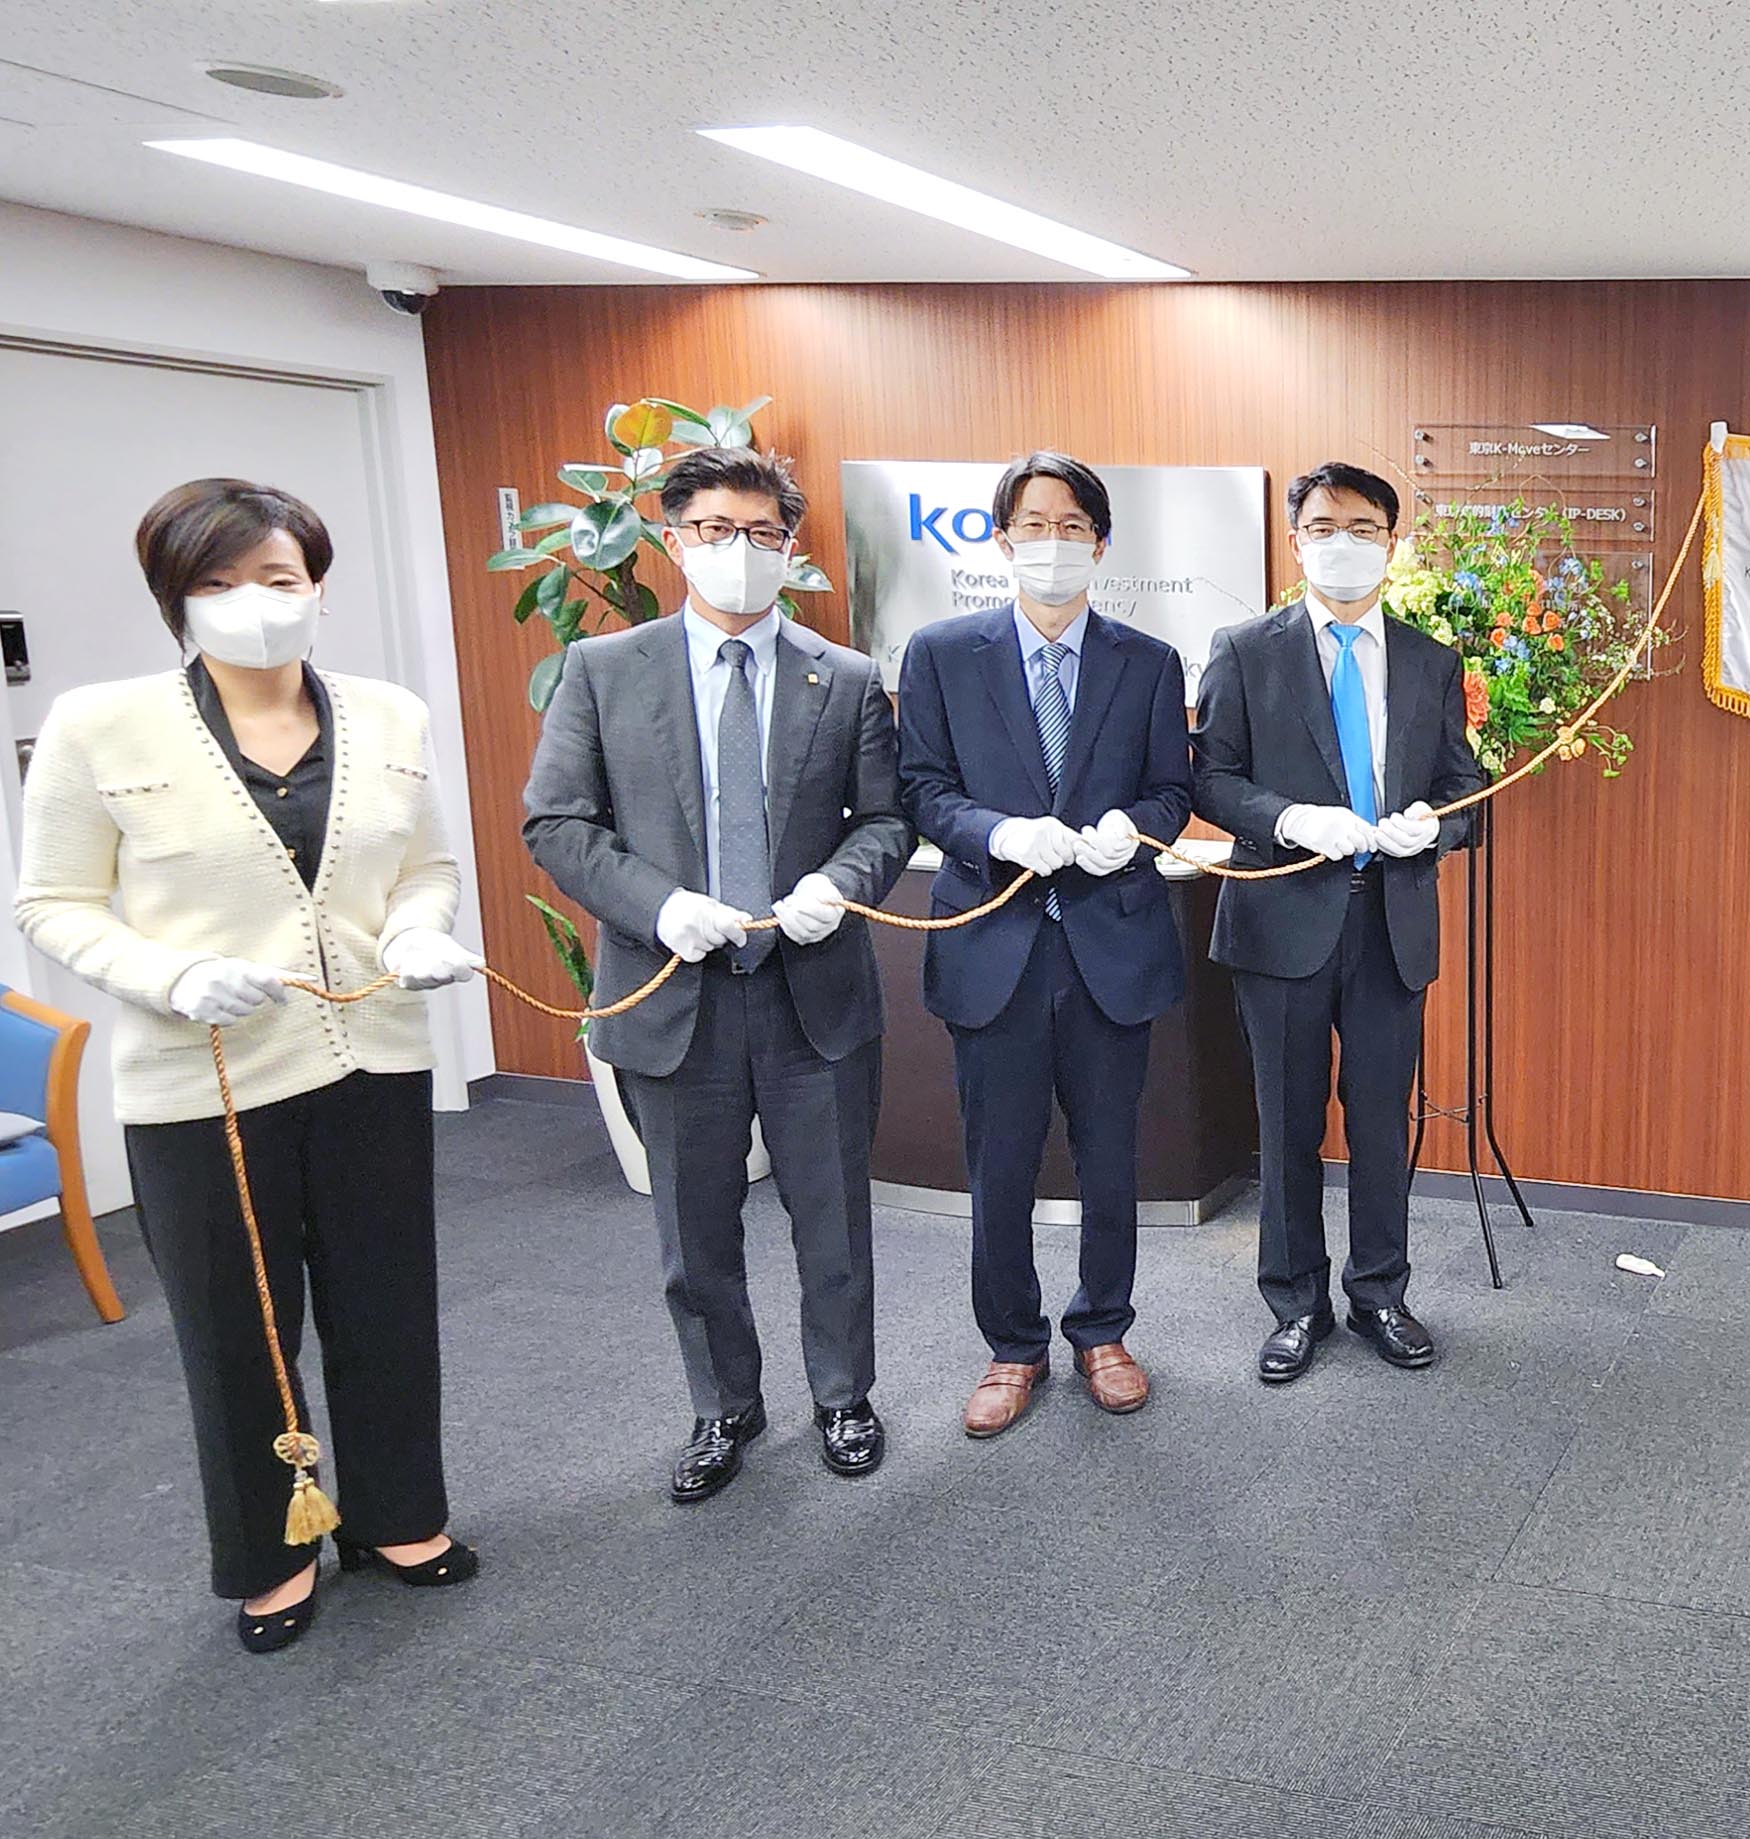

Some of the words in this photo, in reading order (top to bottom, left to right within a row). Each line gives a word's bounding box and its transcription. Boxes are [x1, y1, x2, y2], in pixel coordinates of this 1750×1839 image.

[1468, 441, 1590, 456] 東京K-Moveセンター
[950, 568, 1009, 590] Korea
[1088, 576, 1194, 594] nvestment
[1089, 598, 1137, 618] ency
